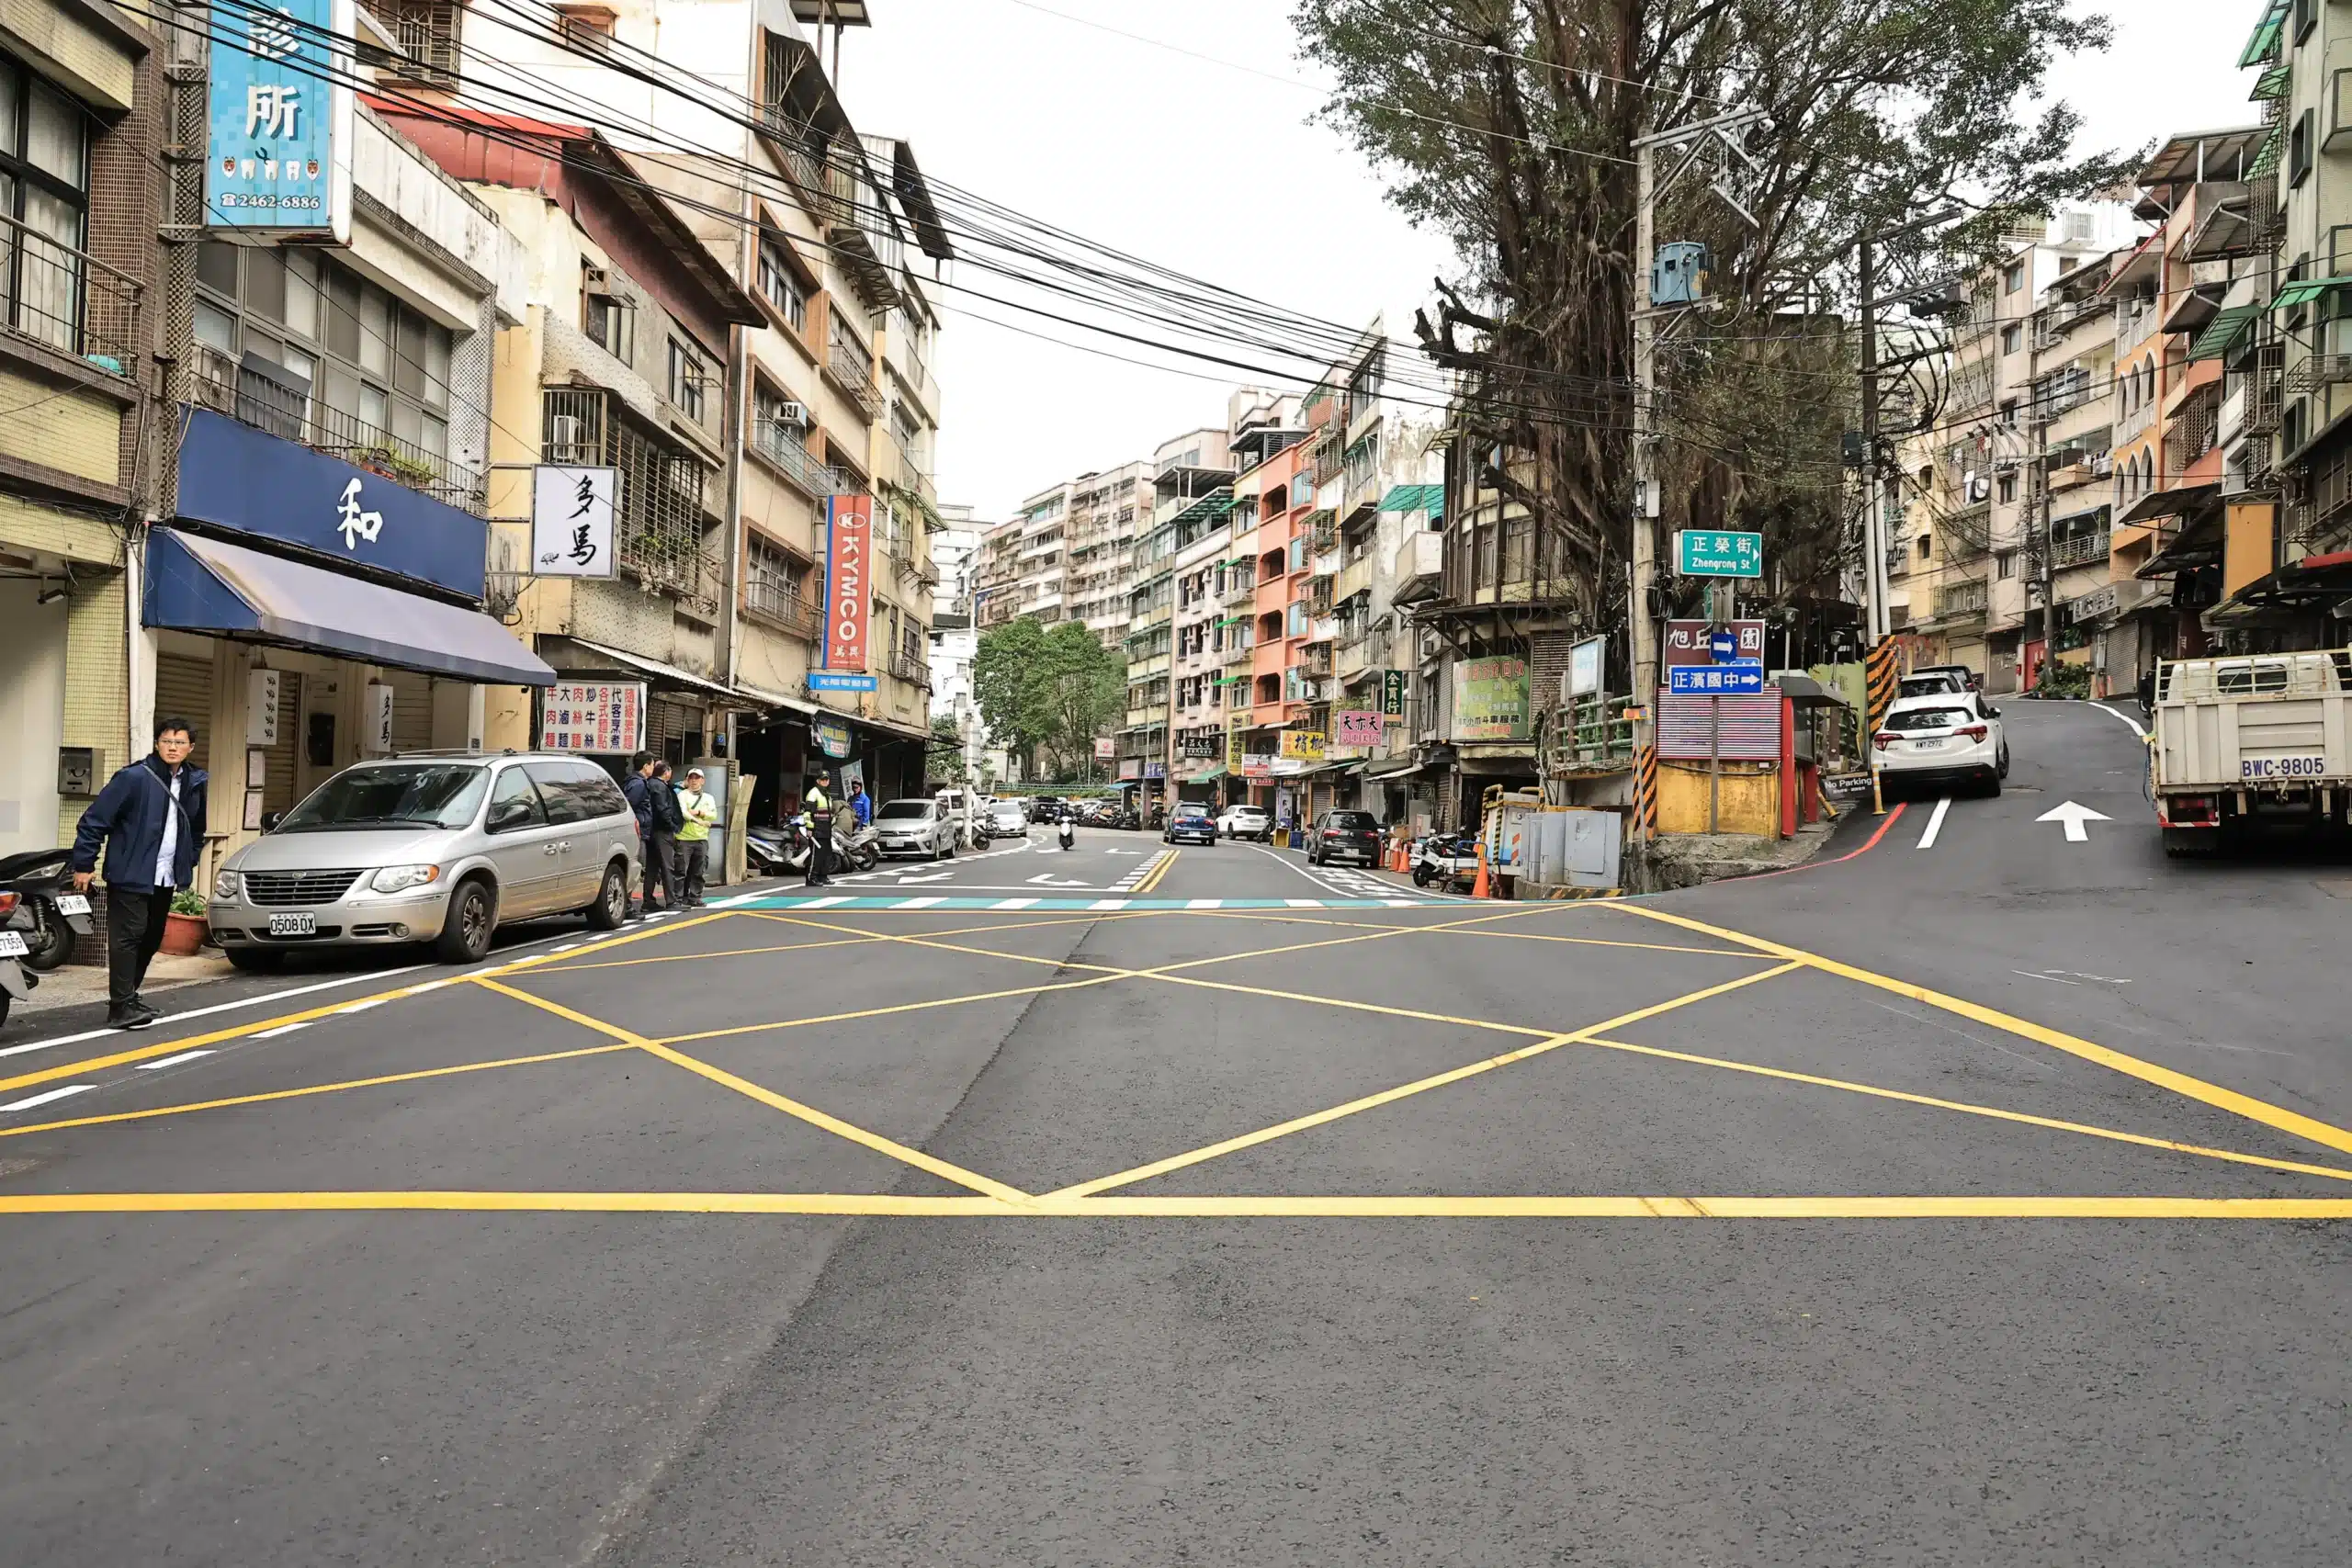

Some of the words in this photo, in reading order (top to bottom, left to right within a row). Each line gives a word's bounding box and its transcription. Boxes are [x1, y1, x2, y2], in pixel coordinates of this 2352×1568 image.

[239, 195, 321, 209] 2462-6886
[336, 477, 384, 550] 和
[566, 474, 597, 567] 多馬
[1691, 536, 1752, 555] 正榮街
[1691, 557, 1737, 571] Zhengrong
[1740, 558, 1752, 570] St.
[838, 535, 860, 642] KYMCO
[1668, 626, 1760, 651] 旭丘園
[1673, 671, 1740, 690] 正濱國中
[545, 686, 557, 748] 牛肉麵
[558, 686, 570, 748] 大滷麵
[571, 687, 583, 748] 肉絲麵
[584, 687, 596, 749] 炒牛絲
[1343, 716, 1379, 731] 天亦天
[2242, 758, 2324, 777] BWC-9805
[1839, 778, 1872, 787] Parking
